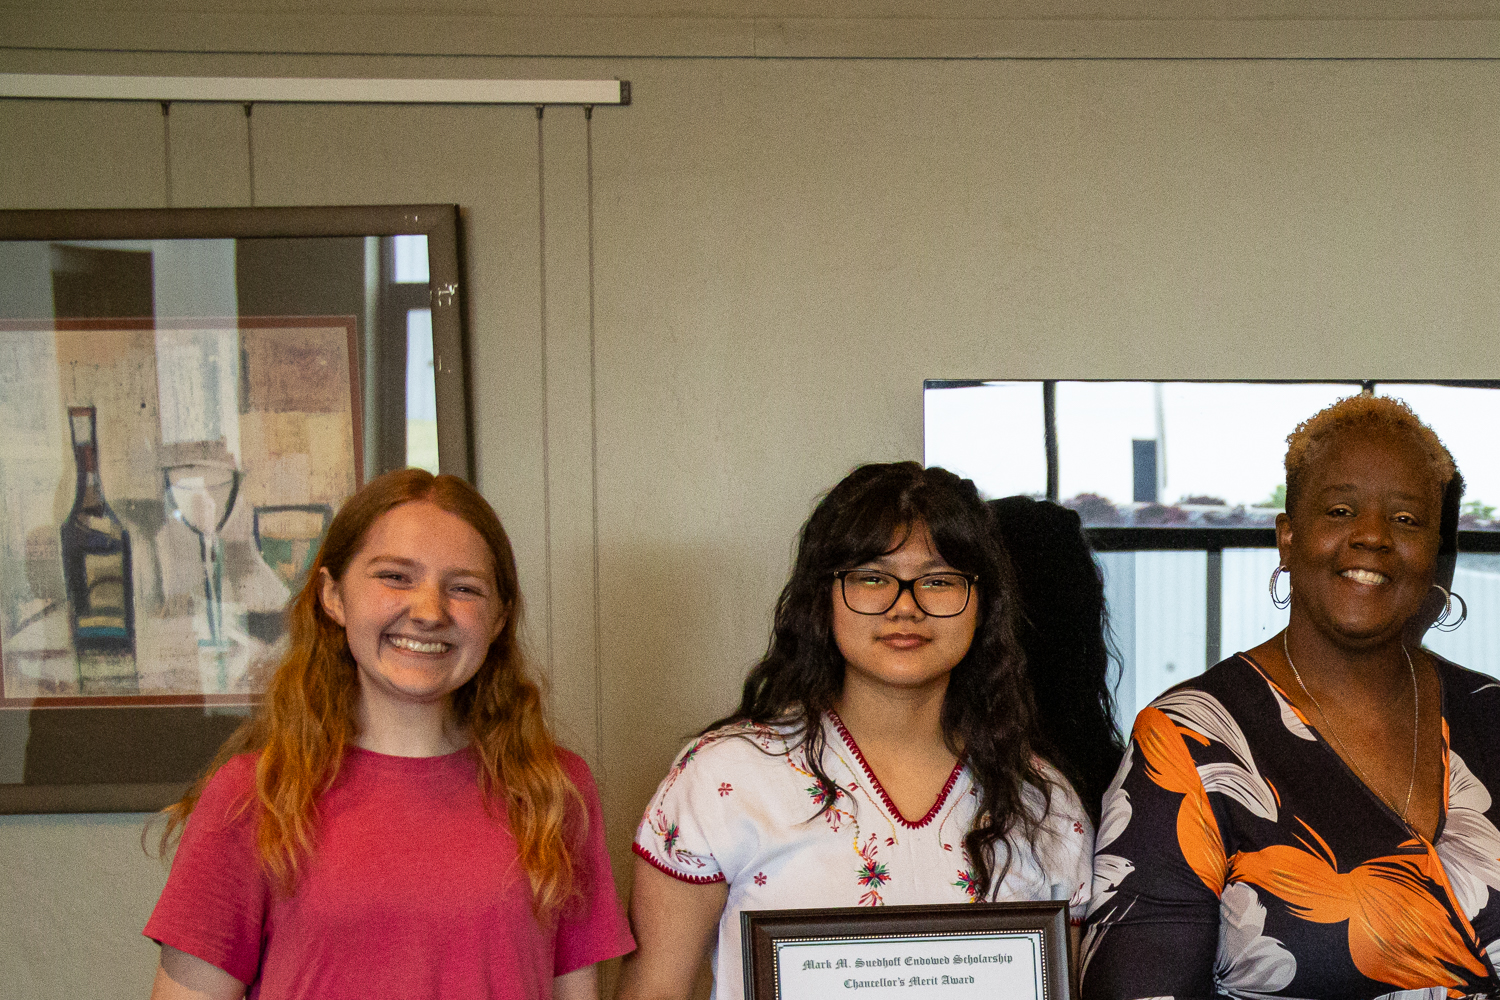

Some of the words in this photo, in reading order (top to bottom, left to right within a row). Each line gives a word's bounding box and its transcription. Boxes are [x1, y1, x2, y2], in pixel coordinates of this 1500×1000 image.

[802, 959, 832, 970] Mark
[835, 958, 851, 969] M.
[854, 957, 901, 968] Suedhoff
[904, 955, 949, 966] Endowed
[952, 953, 1013, 965] Scholarship
[908, 976, 938, 987] Merit
[941, 974, 974, 985] Award
